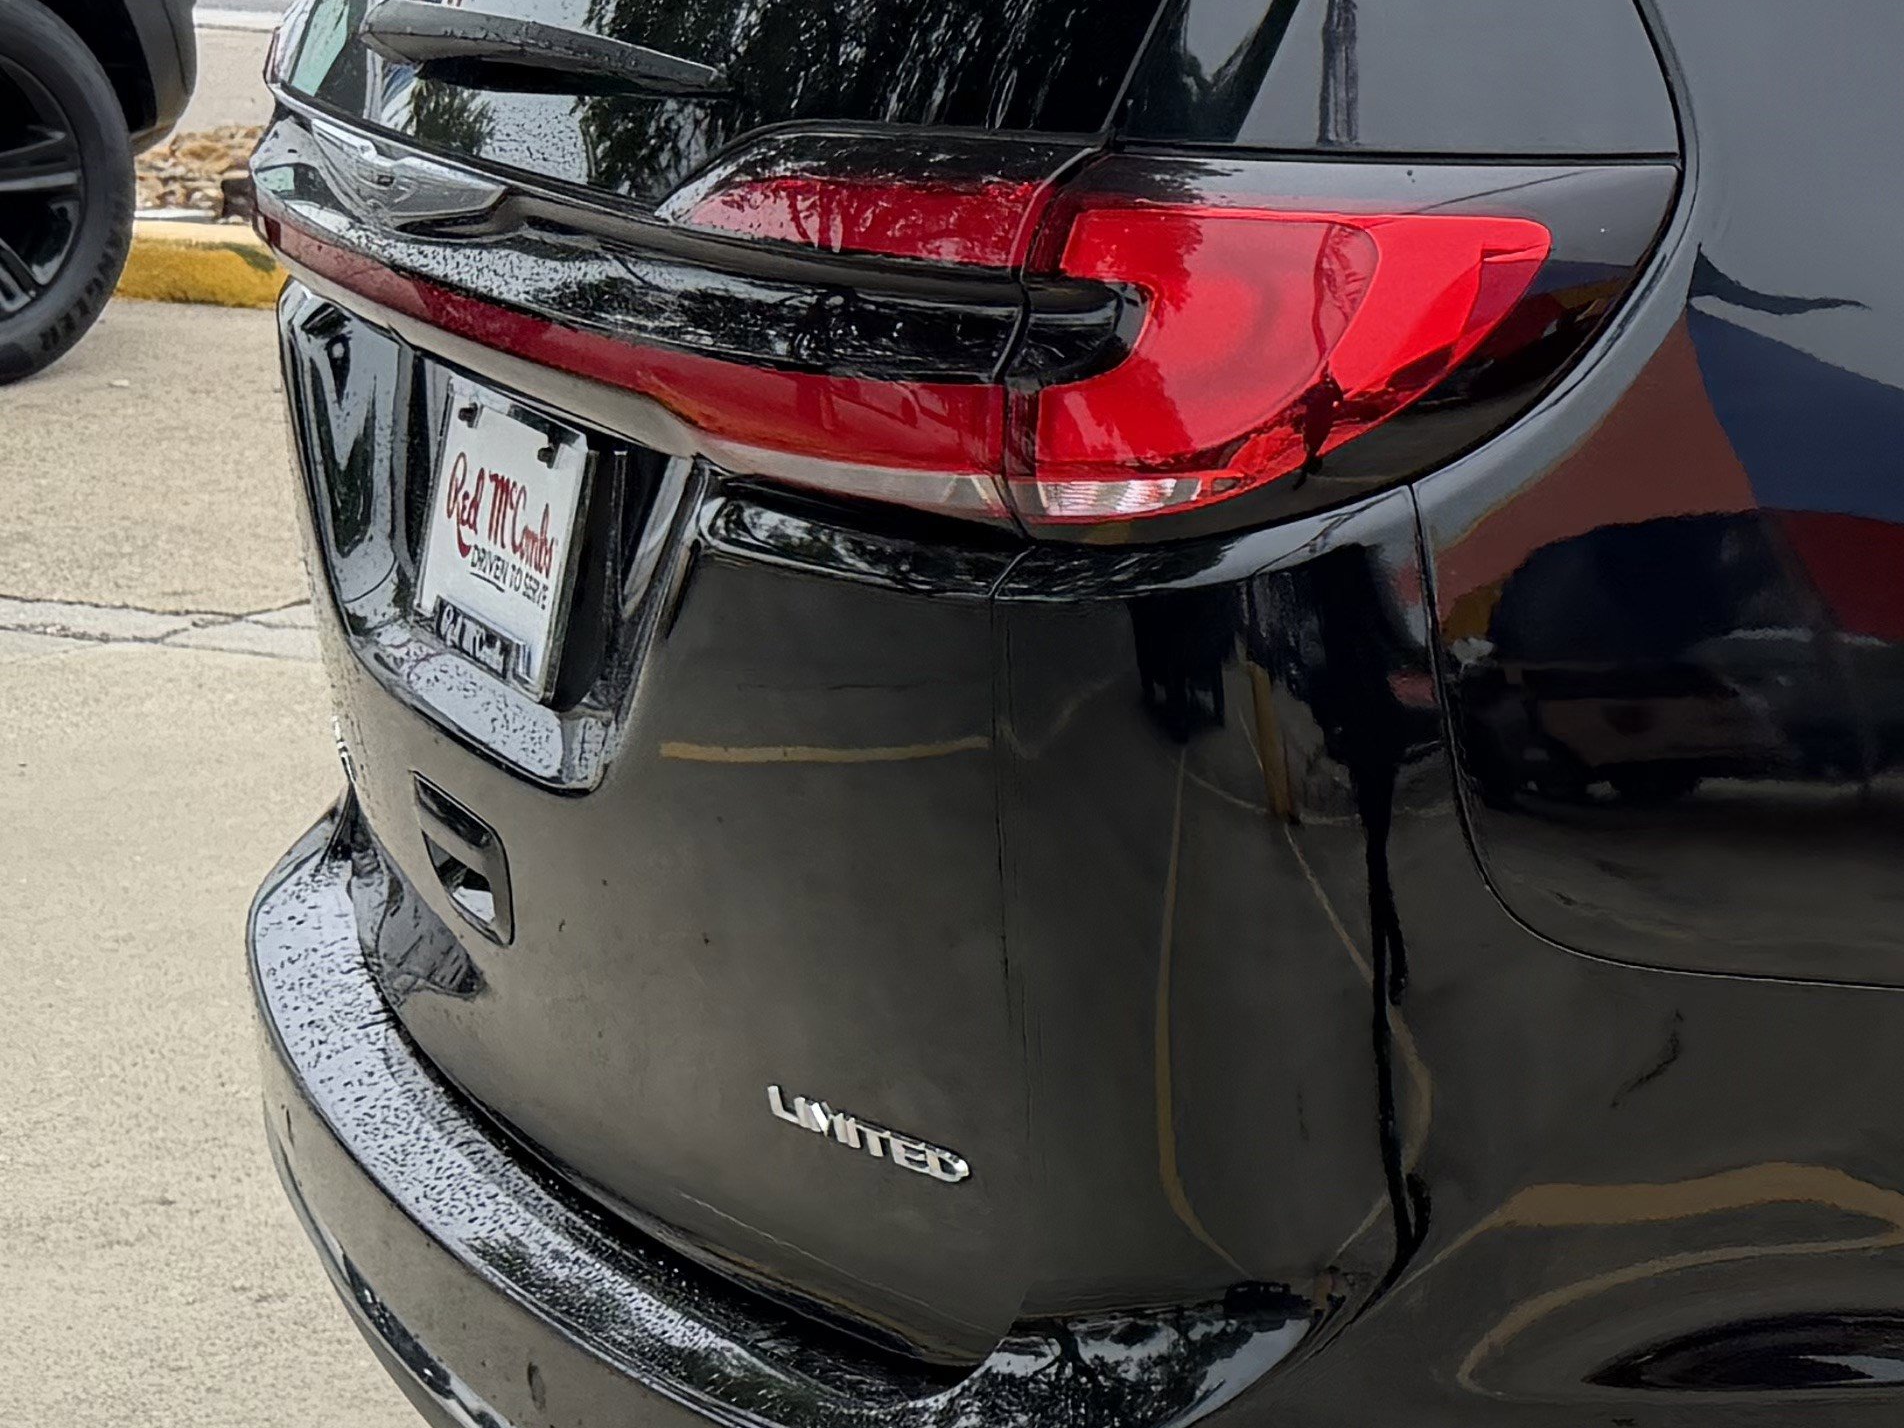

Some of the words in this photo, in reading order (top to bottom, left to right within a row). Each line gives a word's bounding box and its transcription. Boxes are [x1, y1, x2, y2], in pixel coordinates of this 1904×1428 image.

[447, 452, 485, 558] Red
[488, 471, 557, 579] McCombs
[470, 544, 509, 585] DRIVEN
[509, 563, 523, 592] TO
[767, 1084, 970, 1183] LIMITED
